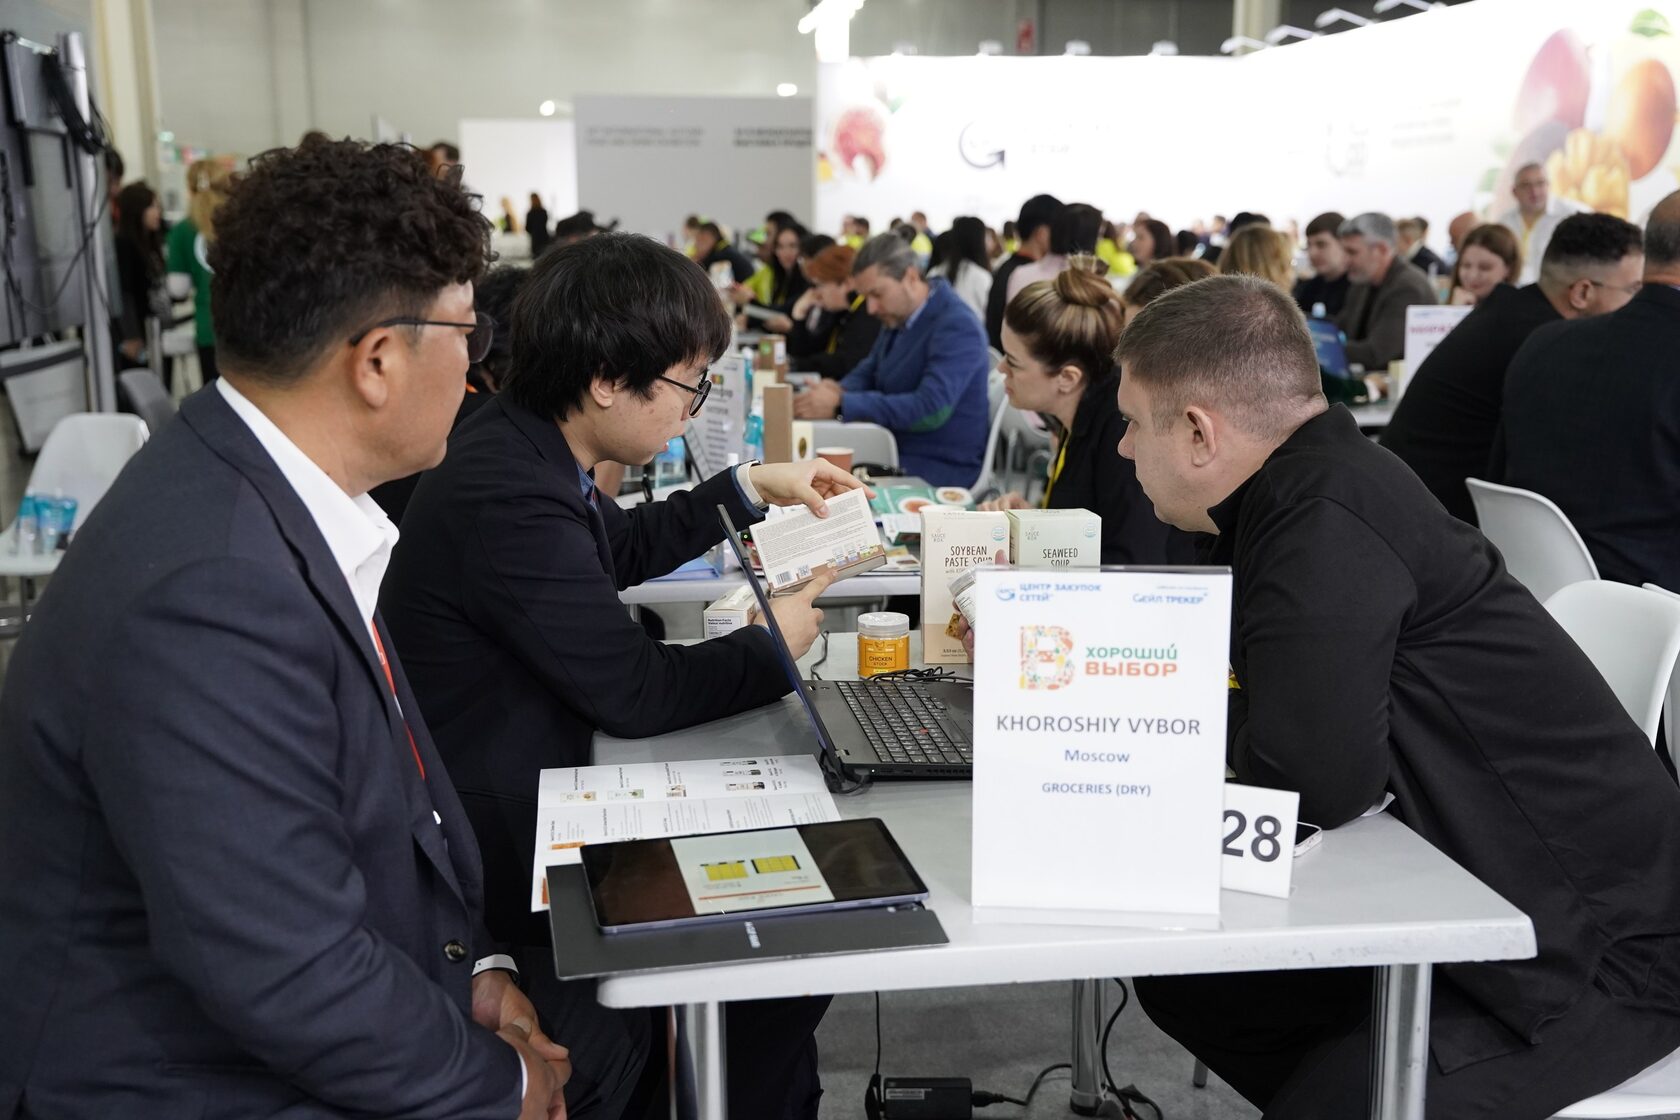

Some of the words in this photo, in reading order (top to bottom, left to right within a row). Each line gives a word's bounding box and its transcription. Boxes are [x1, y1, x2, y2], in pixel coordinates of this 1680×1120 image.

[950, 545, 987, 556] SOYBEAN
[1042, 547, 1079, 559] SEAWEED
[944, 556, 969, 567] PASTE
[1020, 583, 1051, 592] ЦЕНТР
[1055, 584, 1102, 592] ЗАКУПОК
[1085, 662, 1178, 677] ВЫБОР
[996, 715, 1121, 733] KHOROSHIY
[1127, 717, 1201, 735] VYBOR
[1064, 749, 1131, 763] Moscow
[1041, 782, 1112, 795] GROCERIES
[1115, 784, 1152, 797] (DRY)
[1222, 809, 1282, 862] 28
